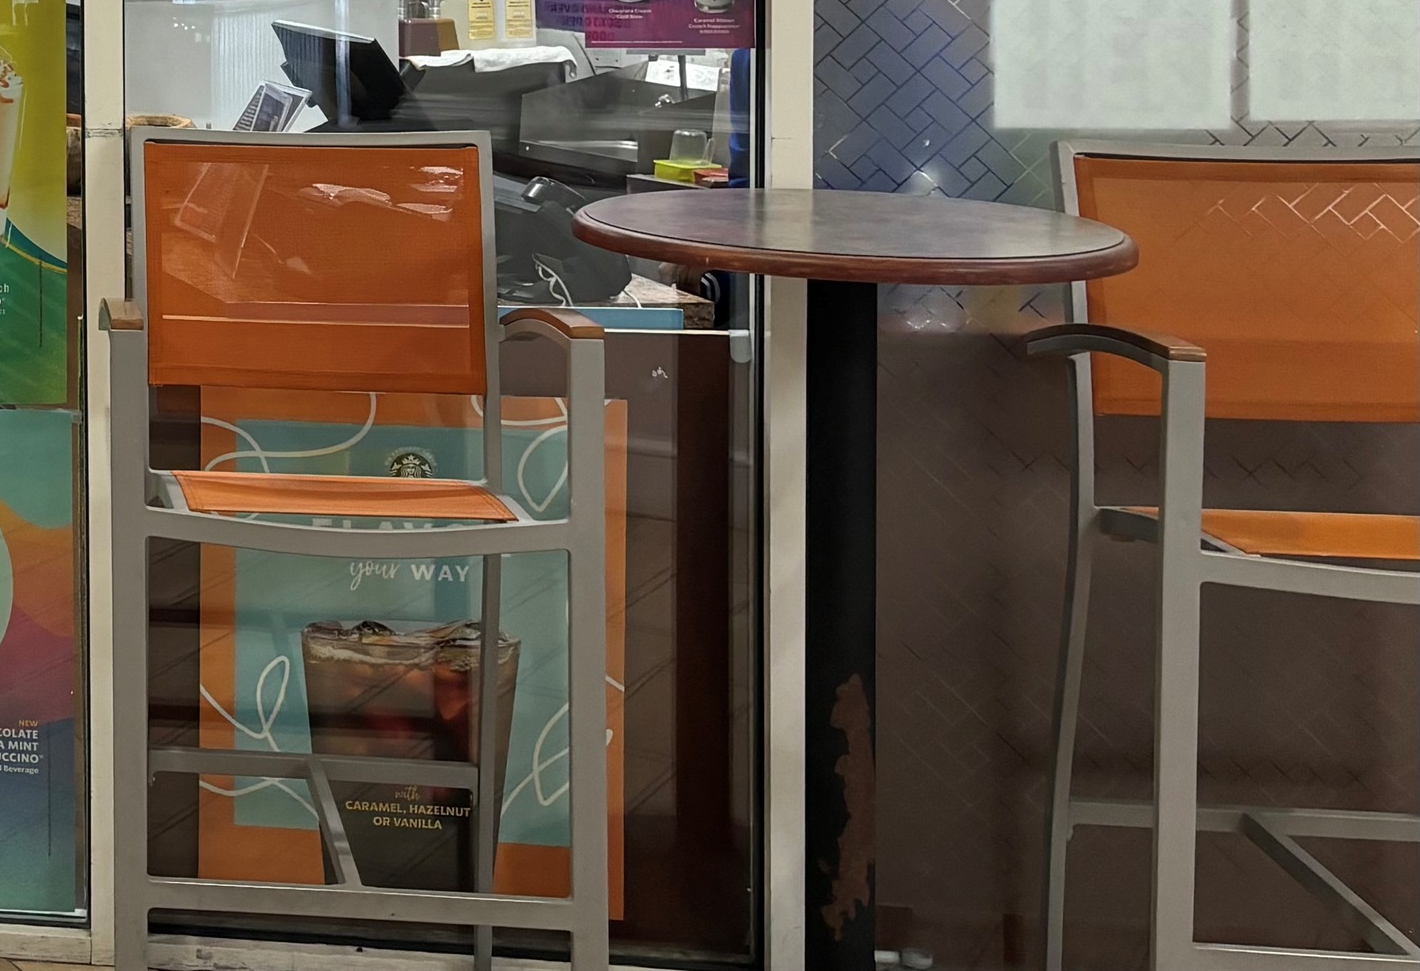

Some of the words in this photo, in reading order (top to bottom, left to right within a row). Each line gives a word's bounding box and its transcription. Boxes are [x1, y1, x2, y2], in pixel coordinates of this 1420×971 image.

[350, 560, 400, 591] your
[411, 564, 470, 582] WAY
[19, 719, 39, 727] NEW
[8, 741, 39, 751] MINT
[3, 765, 39, 774] Beverage
[395, 784, 420, 801] with
[345, 800, 406, 815] CARAMEL,
[409, 804, 471, 818] HAZELNUT
[372, 816, 390, 826] OR
[394, 818, 442, 829] VANILLA
